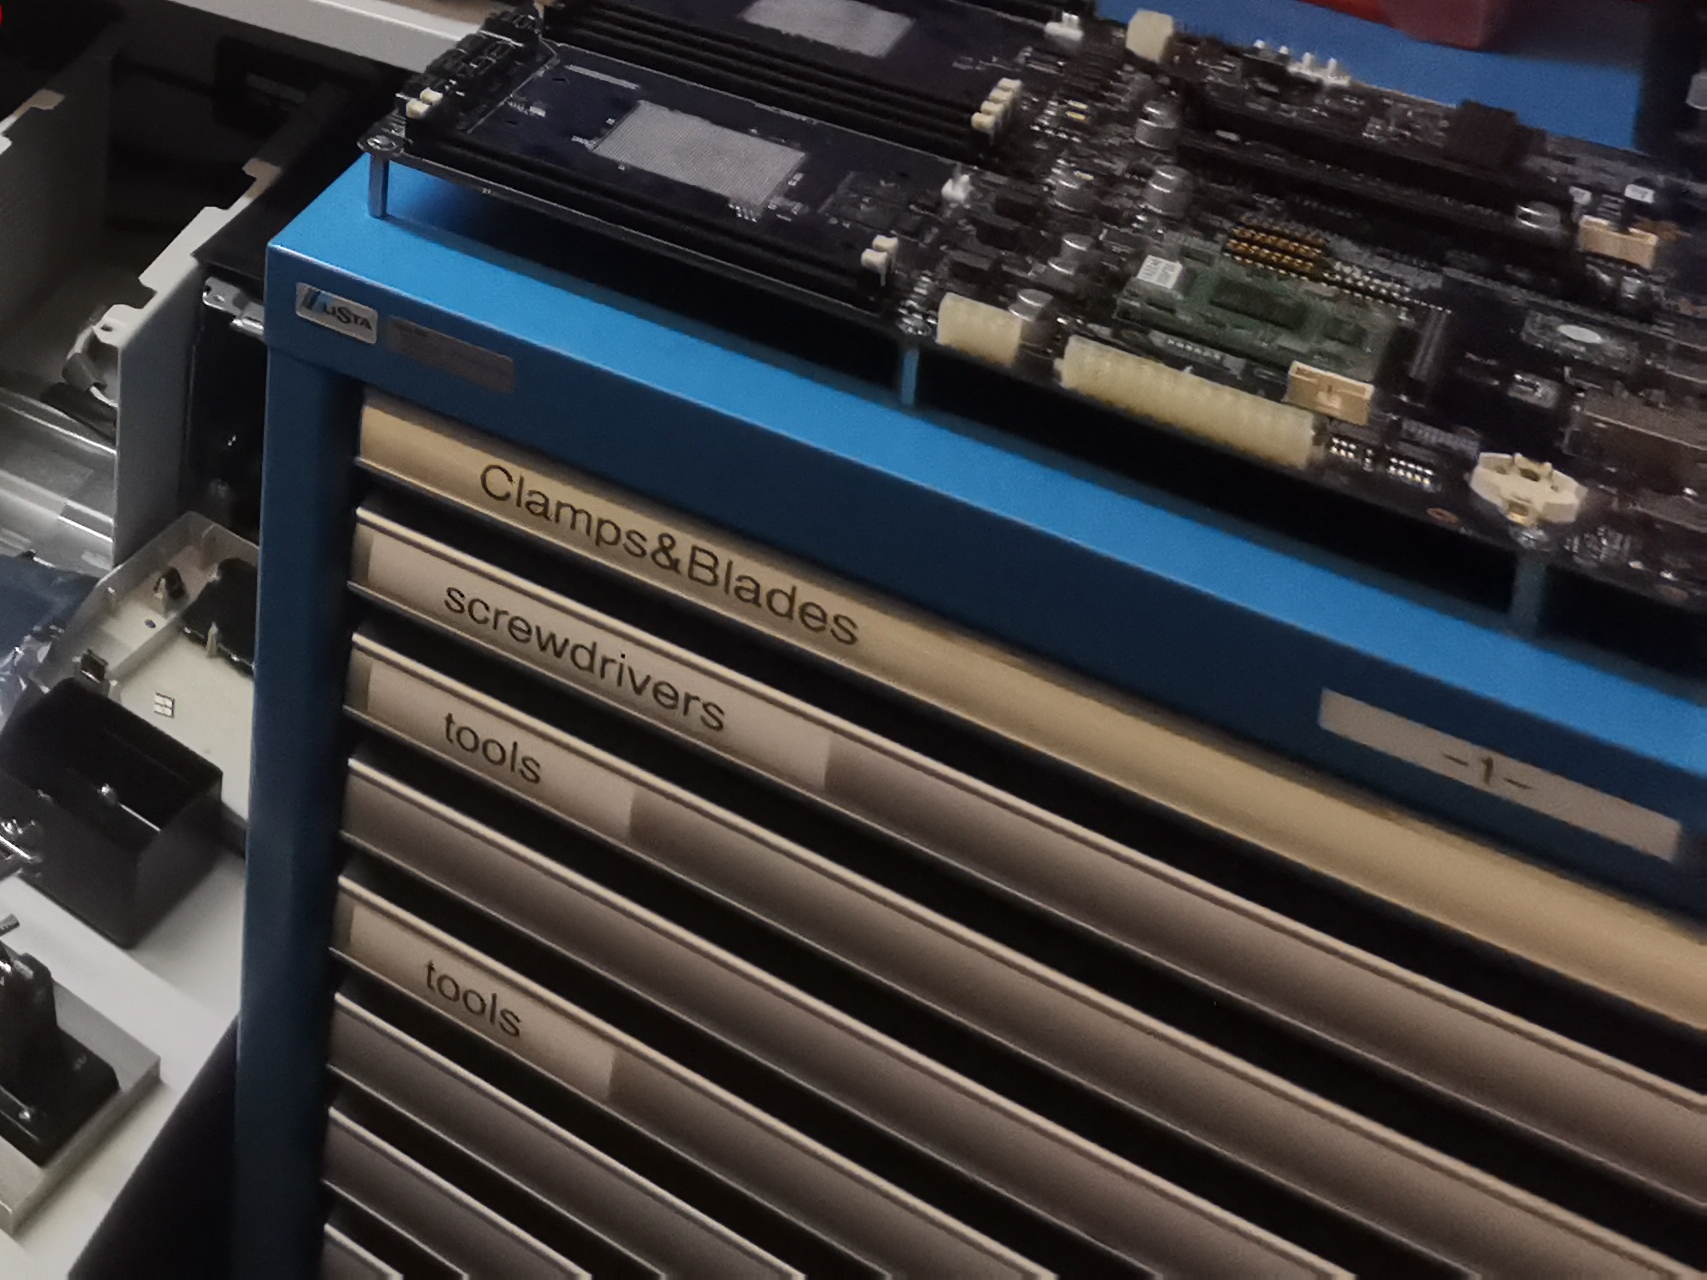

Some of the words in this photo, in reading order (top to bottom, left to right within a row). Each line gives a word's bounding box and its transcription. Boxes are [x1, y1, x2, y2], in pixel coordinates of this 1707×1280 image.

[480, 464, 860, 646] Clamps&Blades
[444, 587, 726, 732] screwdrivers
[444, 712, 542, 784] tools
[426, 960, 522, 1038] tools
